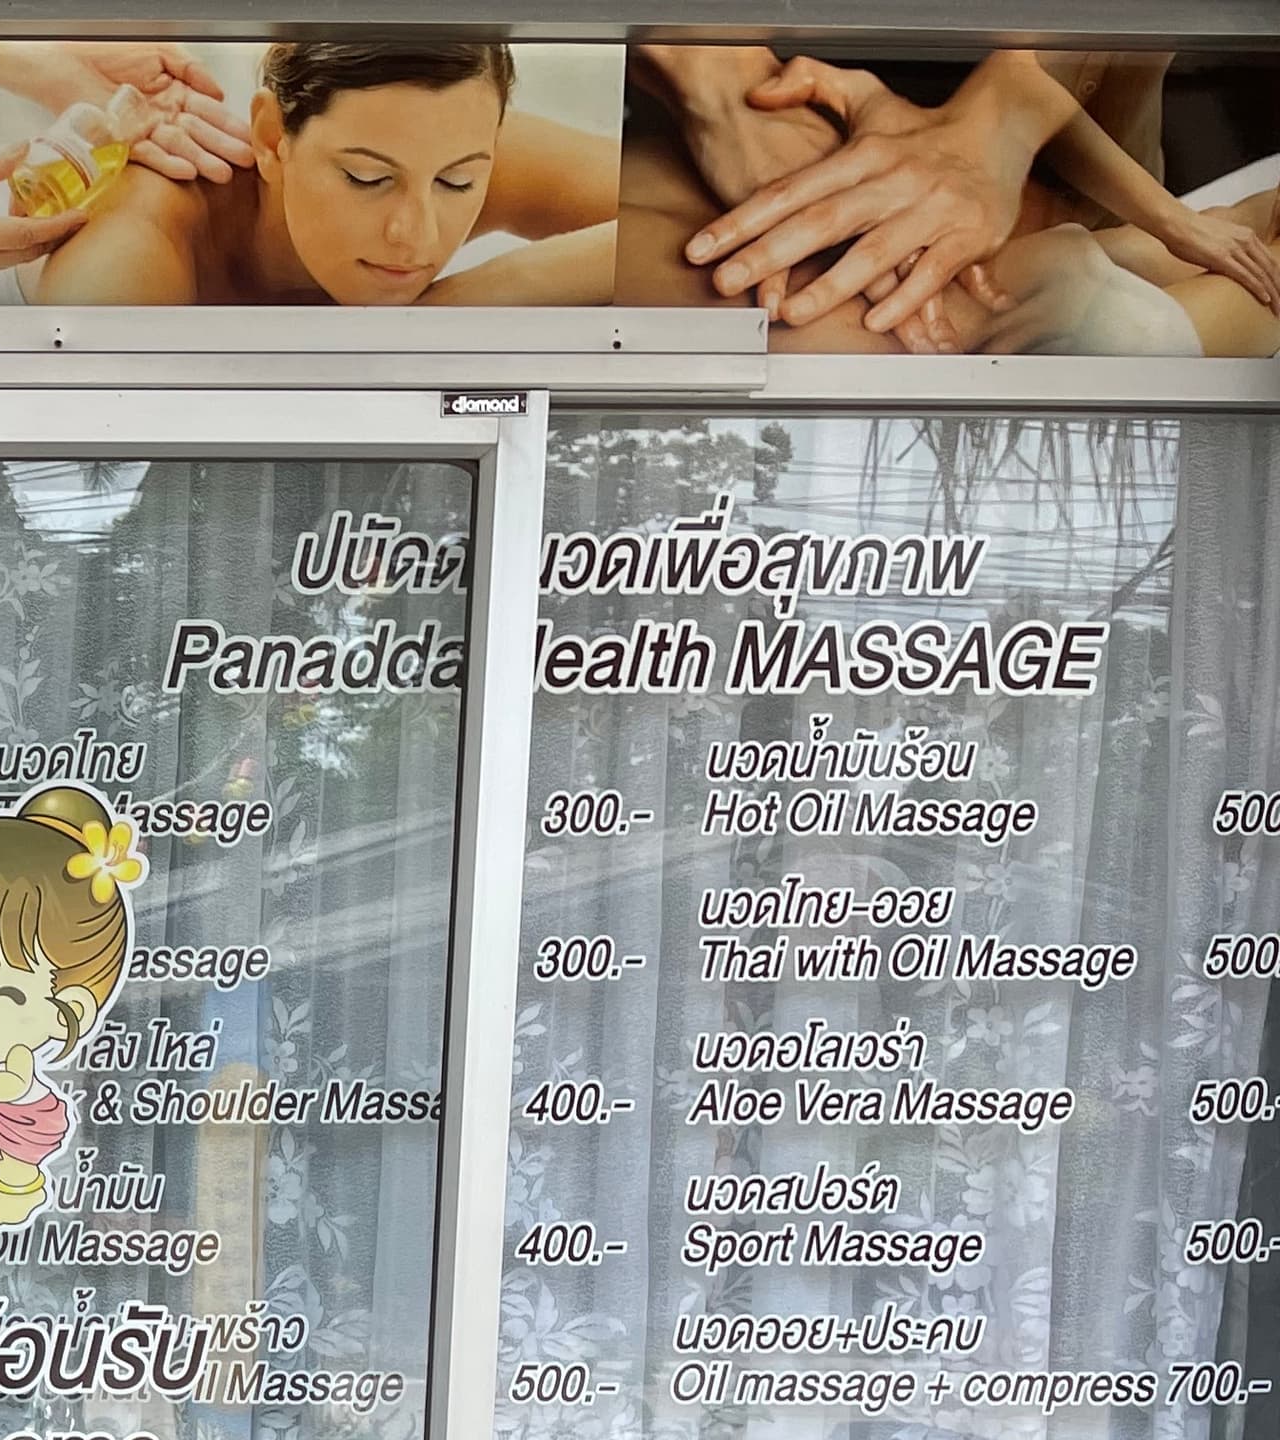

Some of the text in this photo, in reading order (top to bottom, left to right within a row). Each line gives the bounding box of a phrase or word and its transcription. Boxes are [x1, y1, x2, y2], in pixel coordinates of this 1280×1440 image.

[167, 623, 465, 691] Panadda
[730, 624, 1105, 692] MASSAGE
[707, 716, 975, 779] นวดน้ำมันร้อน
[116, 794, 271, 844] assage
[543, 795, 653, 834] 300.-
[703, 794, 1036, 844] Hot Oil Massage
[130, 948, 270, 988] assage
[537, 940, 645, 979] 300.-
[702, 942, 1136, 991] Thai with Oil Massage
[79, 1020, 220, 1069] ลัง ไหล่
[695, 1020, 926, 1070] นวดอโลเวร่า
[92, 1082, 123, 1122] &
[132, 1081, 316, 1122] Shoulder
[525, 1085, 634, 1124] 400.-
[688, 1084, 1074, 1131] Aloe Vera Massage
[1192, 1079, 1280, 1122] 500.
[685, 1163, 899, 1212] นวดสปอร์ต
[41, 1223, 219, 1273] Massage
[515, 1226, 627, 1265] 400.-
[683, 1227, 987, 1273] Sport Massage
[675, 1305, 985, 1352] นวดออย+ประคบ
[226, 1362, 405, 1411] Massage
[510, 1365, 619, 1403] 500.-
[671, 1365, 1157, 1411] Oil massage + compress
[1167, 1365, 1273, 1404] 700.-
